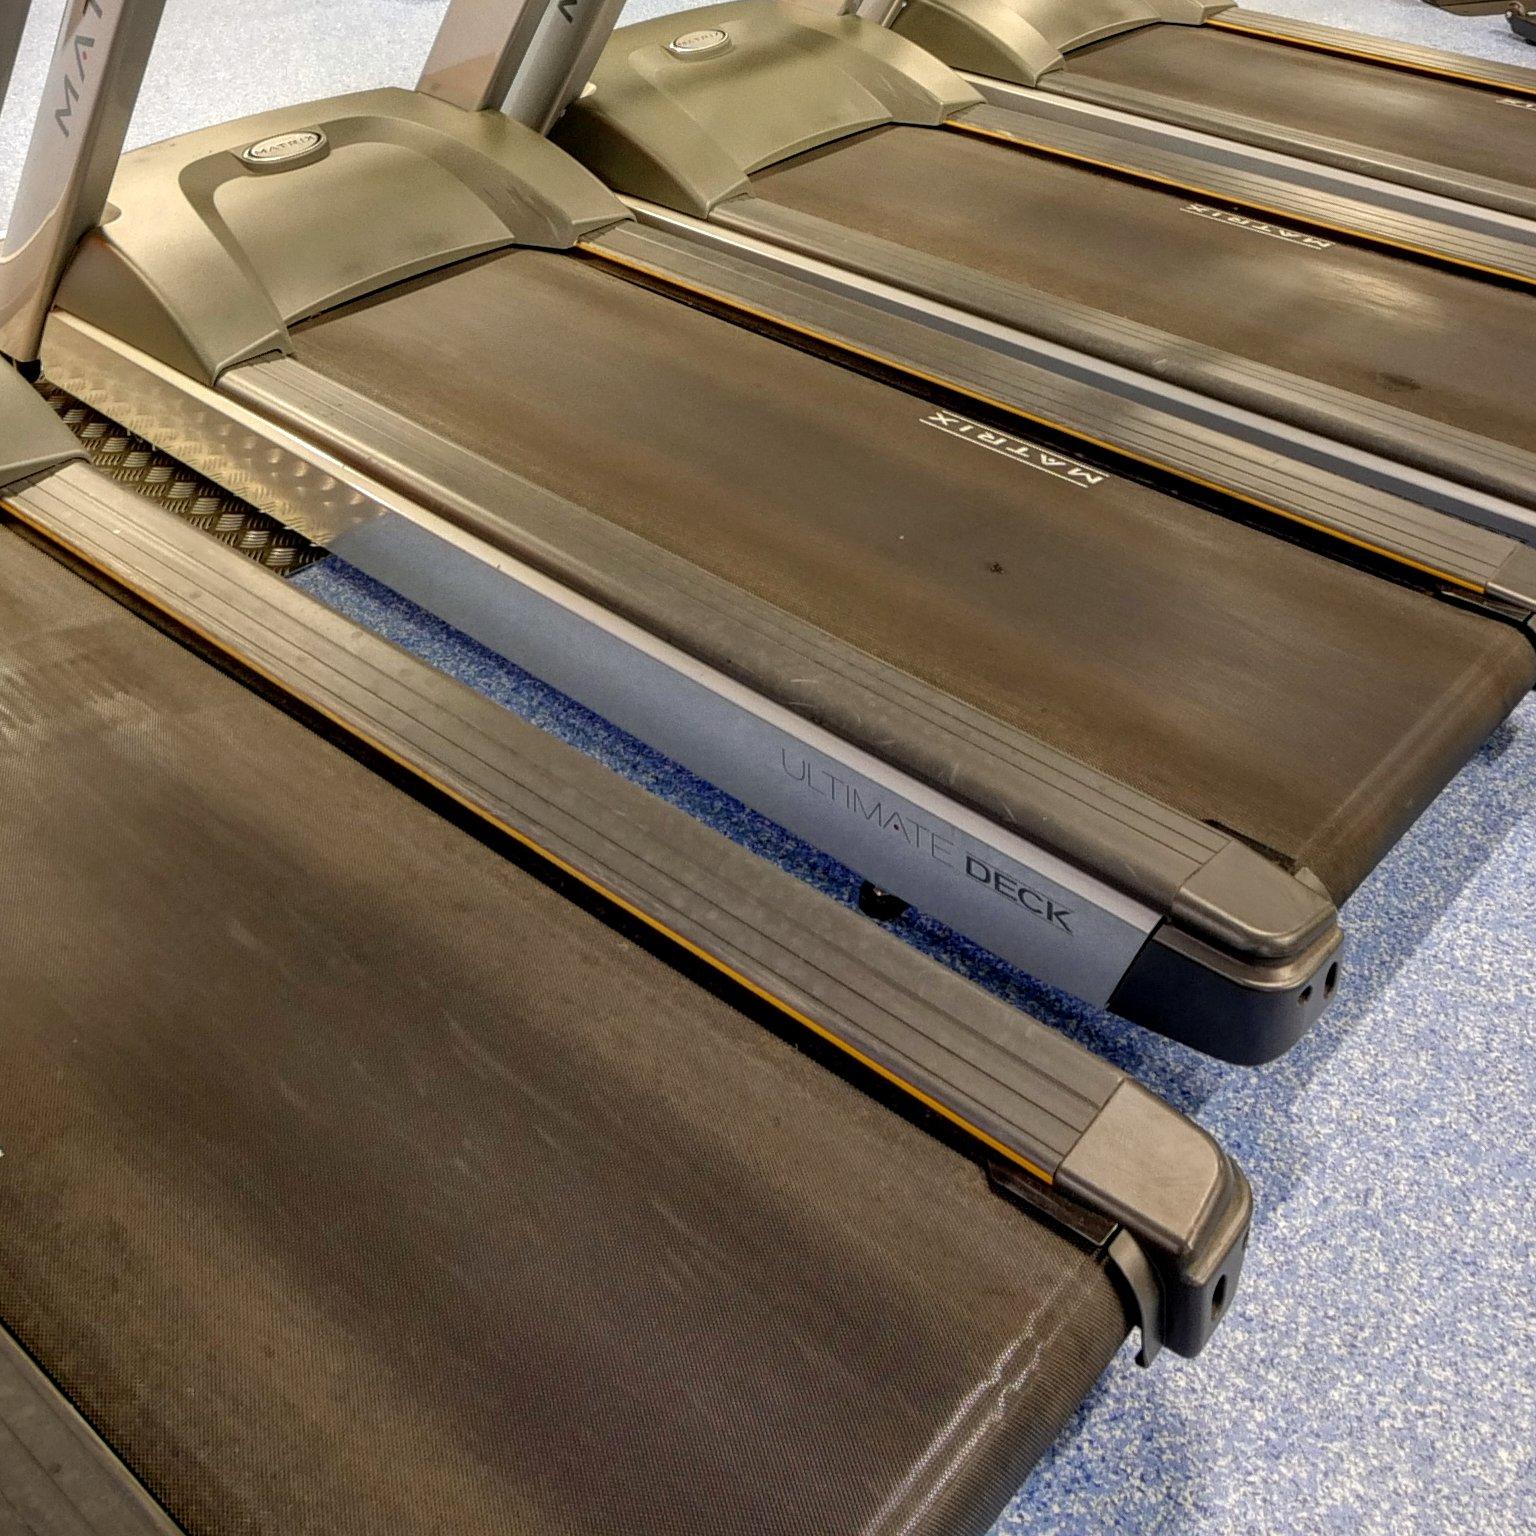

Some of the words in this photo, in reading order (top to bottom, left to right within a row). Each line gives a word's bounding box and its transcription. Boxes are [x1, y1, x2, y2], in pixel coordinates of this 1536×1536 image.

[1186, 202, 1334, 248] MATRIX
[927, 411, 1104, 485] MATRIX
[781, 747, 957, 869] ULTIMATE
[965, 853, 1075, 937] DECK
